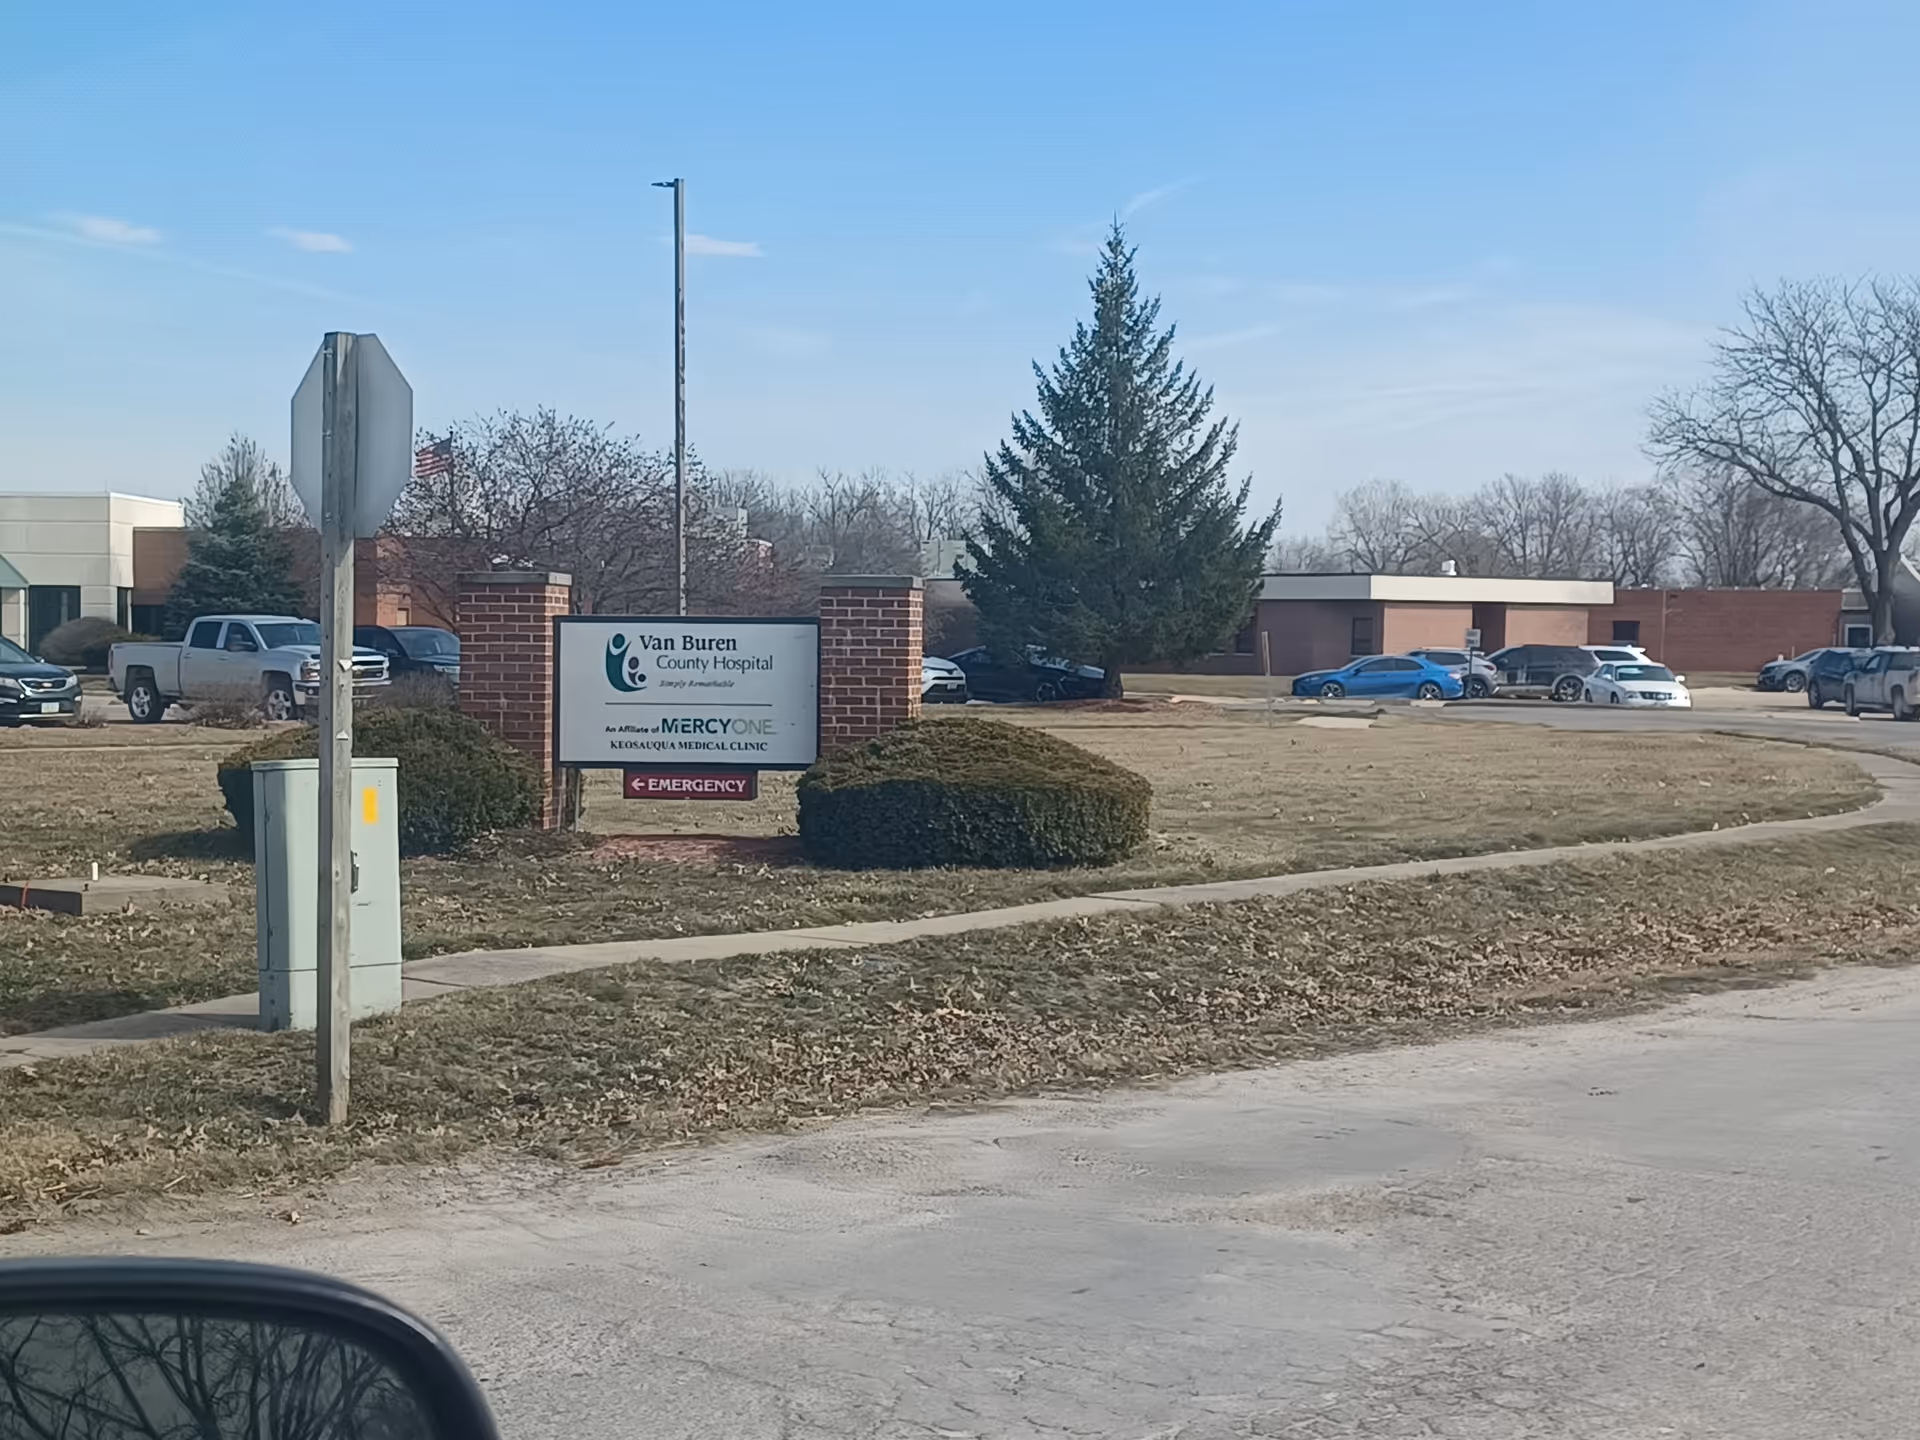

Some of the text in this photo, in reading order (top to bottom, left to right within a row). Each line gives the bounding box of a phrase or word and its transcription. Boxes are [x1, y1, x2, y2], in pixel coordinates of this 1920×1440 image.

[640, 635, 737, 651] Van Buren
[656, 655, 773, 674] County Hospital
[618, 725, 649, 733] Affiliate
[650, 725, 660, 734] of
[610, 740, 768, 752] KEOSAUQUA MEDICAL CLINIC
[647, 778, 746, 793] EMERGENCY
